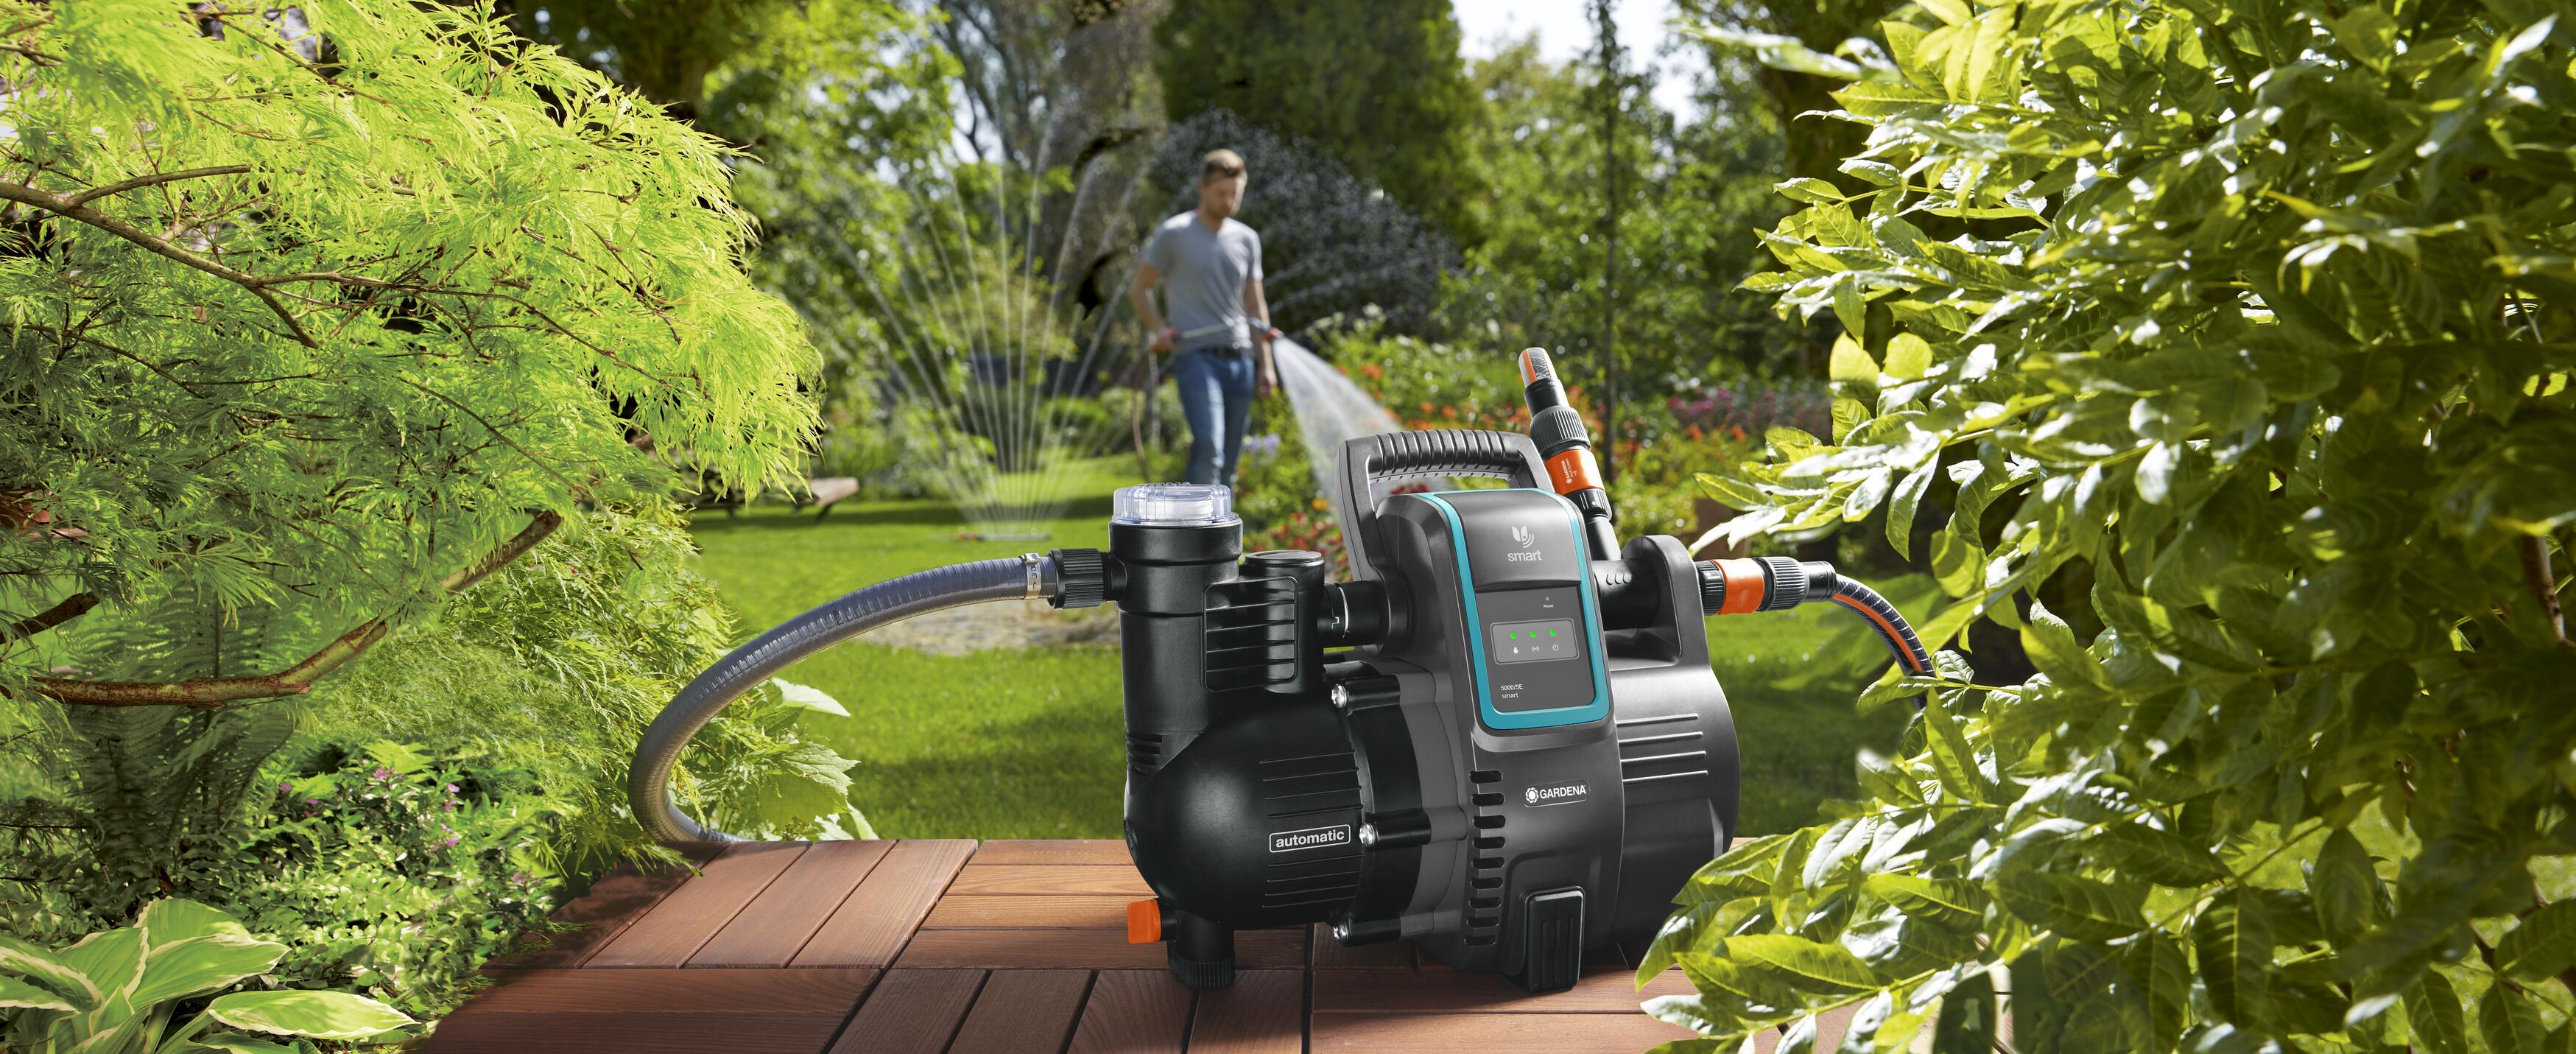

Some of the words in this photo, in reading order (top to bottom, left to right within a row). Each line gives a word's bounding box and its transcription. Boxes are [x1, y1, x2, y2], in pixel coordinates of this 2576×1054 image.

[1507, 550, 1542, 561] smart
[1540, 785, 1586, 798] GARDENA
[1275, 829, 1345, 848] automatic
